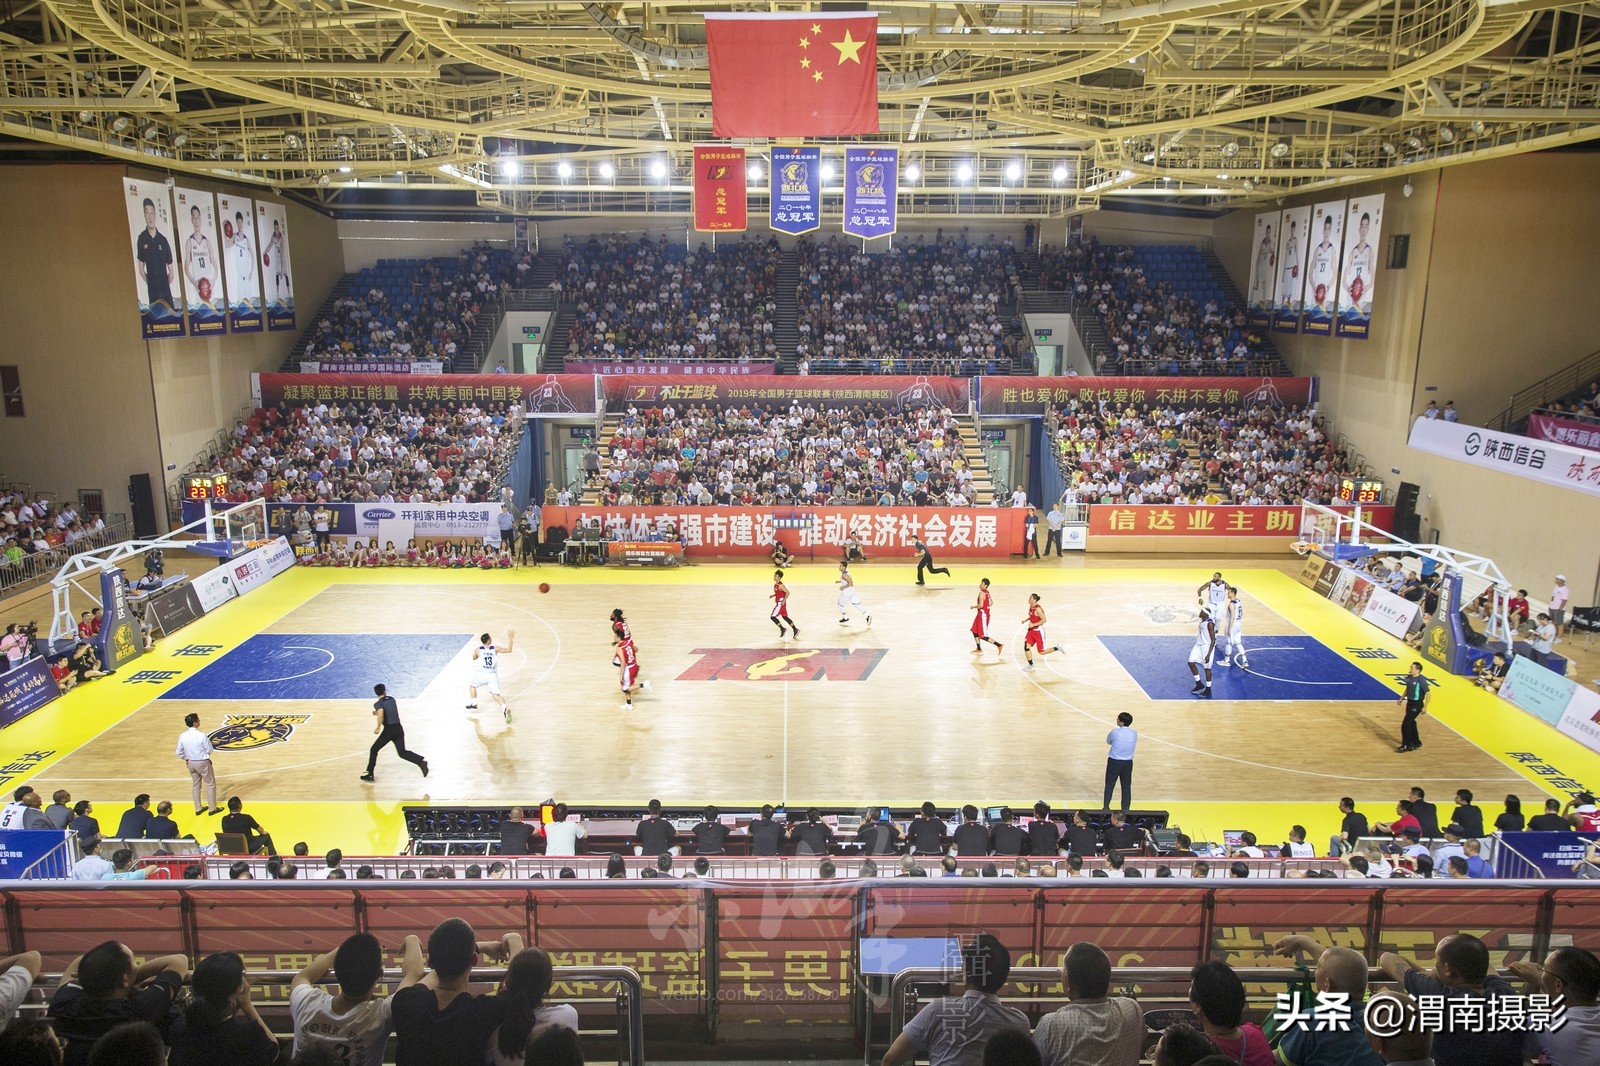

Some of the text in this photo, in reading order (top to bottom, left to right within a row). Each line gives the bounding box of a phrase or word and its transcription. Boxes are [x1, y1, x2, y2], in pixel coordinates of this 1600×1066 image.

[716, 187, 727, 214] 总冠军
[775, 212, 815, 222] 总冠军
[849, 216, 891, 226] 总冠军
[198, 258, 206, 268] 13
[684, 366, 750, 374] 健康中华民族
[284, 385, 523, 400] 凝聚篮球正能量 共筑美丽中国梦
[544, 388, 552, 397] 23
[912, 389, 922, 399] 23
[1003, 388, 1239, 404] 胜也爱你 败也爱你 不拼不爱你
[1258, 390, 1267, 400] 23
[1483, 439, 1546, 469] 陕西信合
[191, 488, 207, 498] 23
[216, 485, 225, 497] 23
[1358, 491, 1375, 502] 23
[366, 511, 392, 519] Carrier
[401, 510, 489, 521] 开利家用中央空调
[798, 514, 997, 548] 推动经济社会发展
[484, 656, 493, 666] 13
[2, 814, 12, 827] 5
